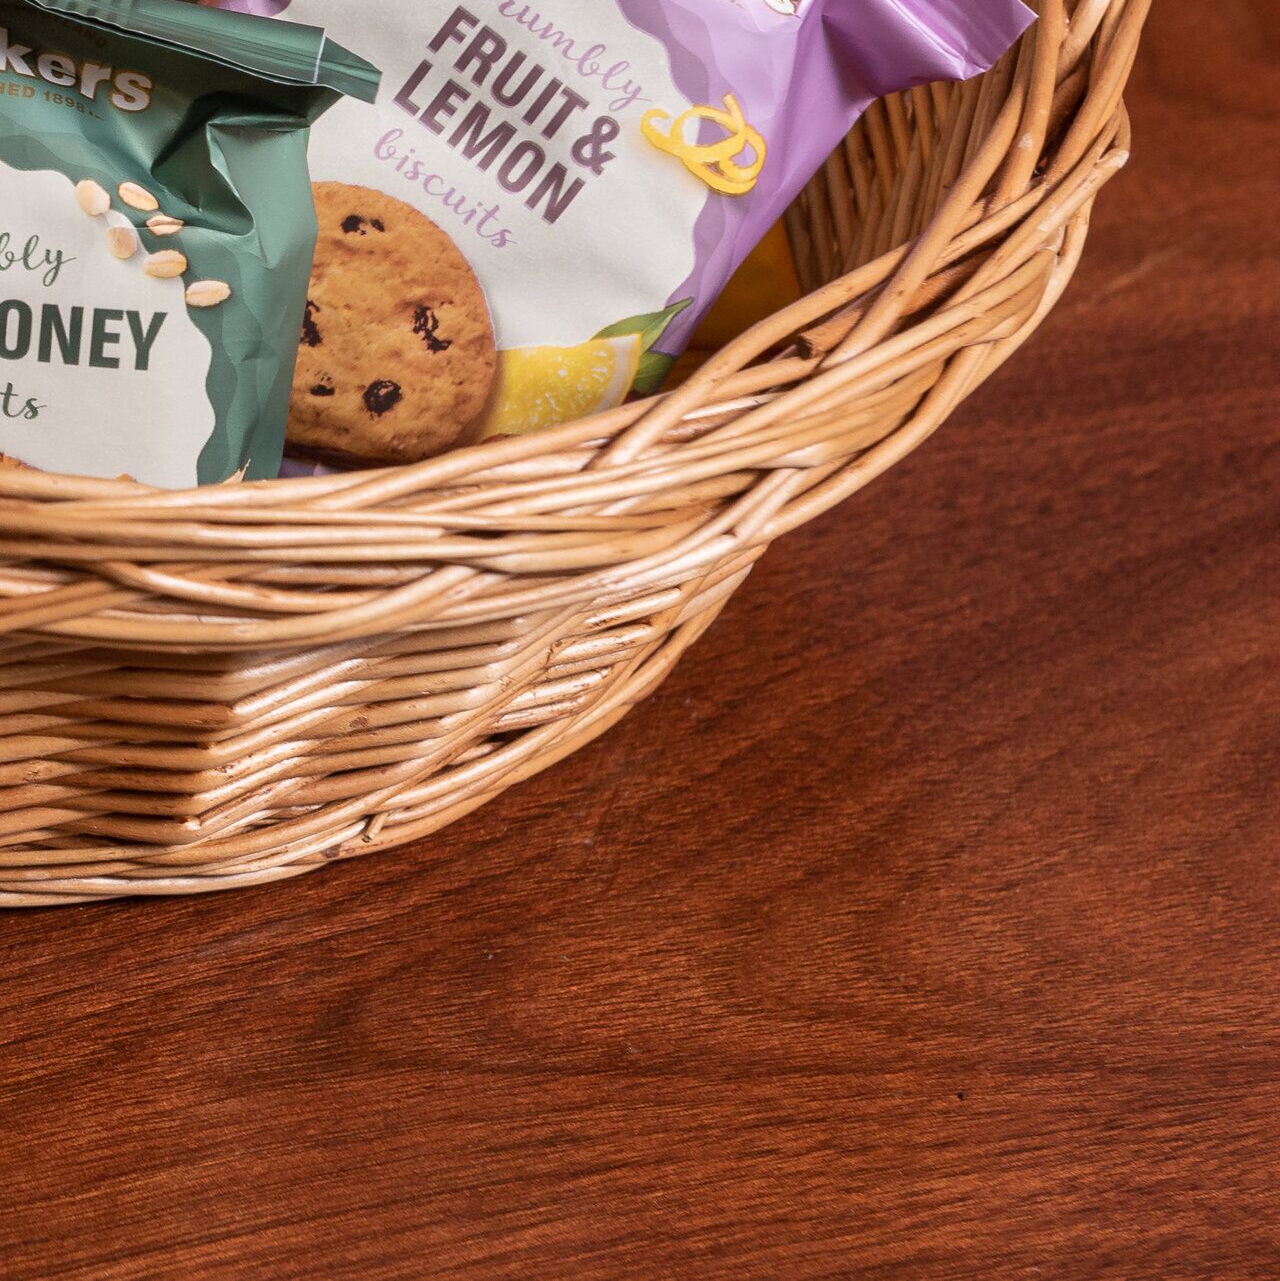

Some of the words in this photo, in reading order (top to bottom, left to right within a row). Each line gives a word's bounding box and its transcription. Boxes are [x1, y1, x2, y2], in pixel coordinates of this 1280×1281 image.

[43, 89, 87, 115] 1898
[391, 58, 587, 227] LEMON
[424, 4, 591, 140] FRUIT
[570, 114, 622, 177] &
[372, 126, 519, 251] biscuits
